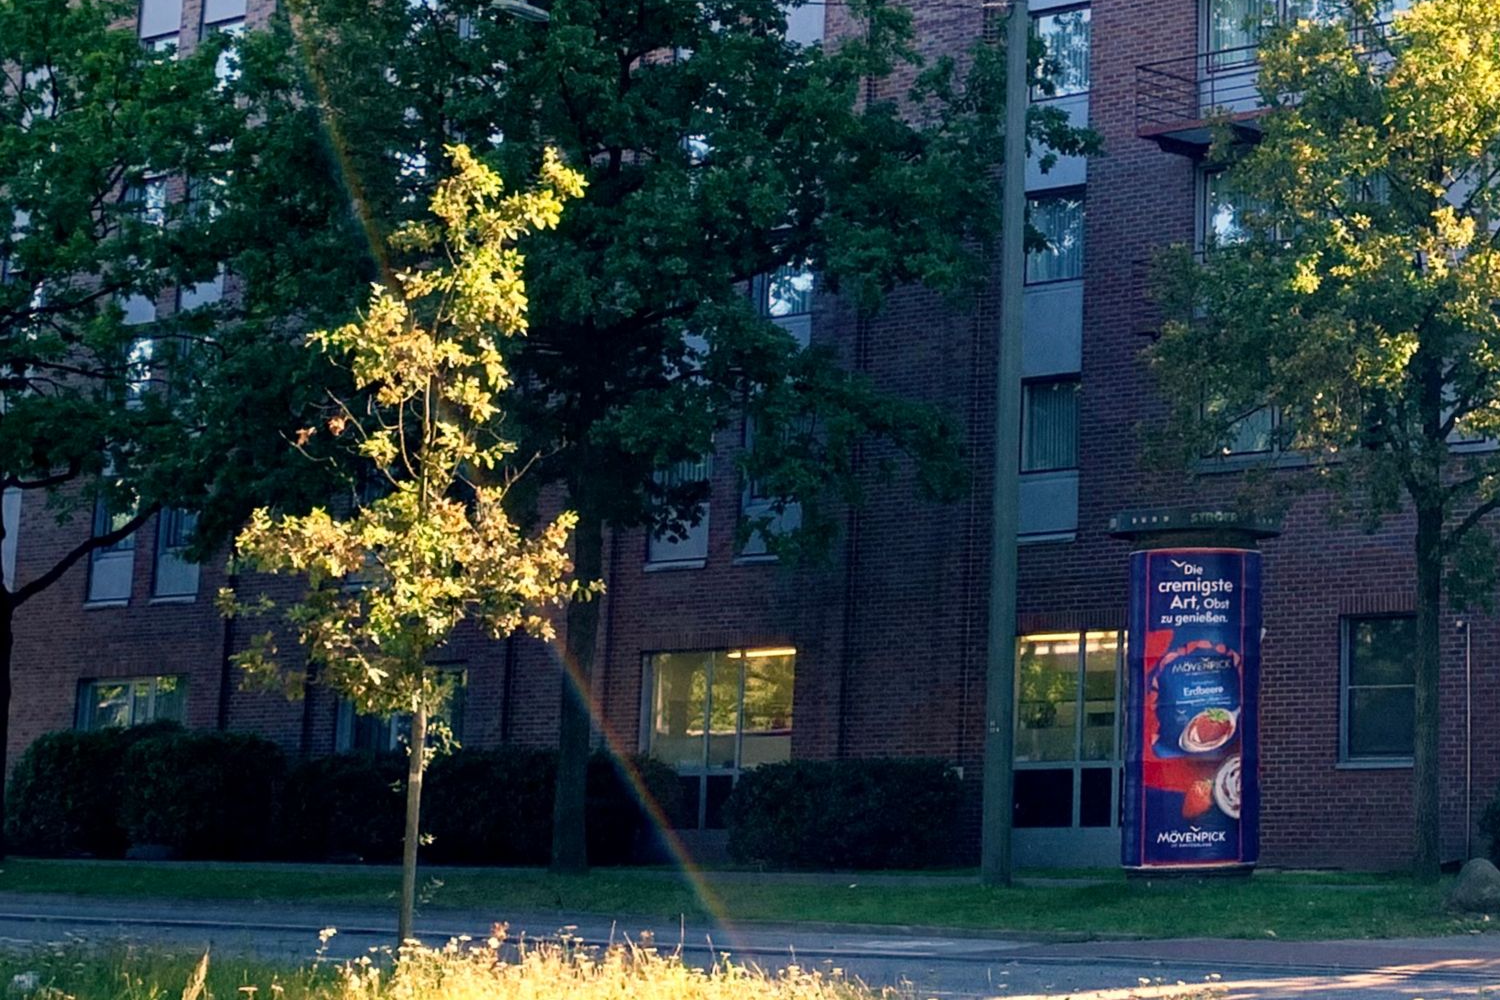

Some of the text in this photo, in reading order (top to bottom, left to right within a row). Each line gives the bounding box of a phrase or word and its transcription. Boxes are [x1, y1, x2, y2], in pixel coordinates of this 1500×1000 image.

[1184, 563, 1204, 575] Die
[1158, 577, 1234, 596] cremigste
[1170, 595, 1230, 610] Art, Obst
[1160, 610, 1229, 626] zu genießen.
[1156, 830, 1227, 844] MÖVENPICK
